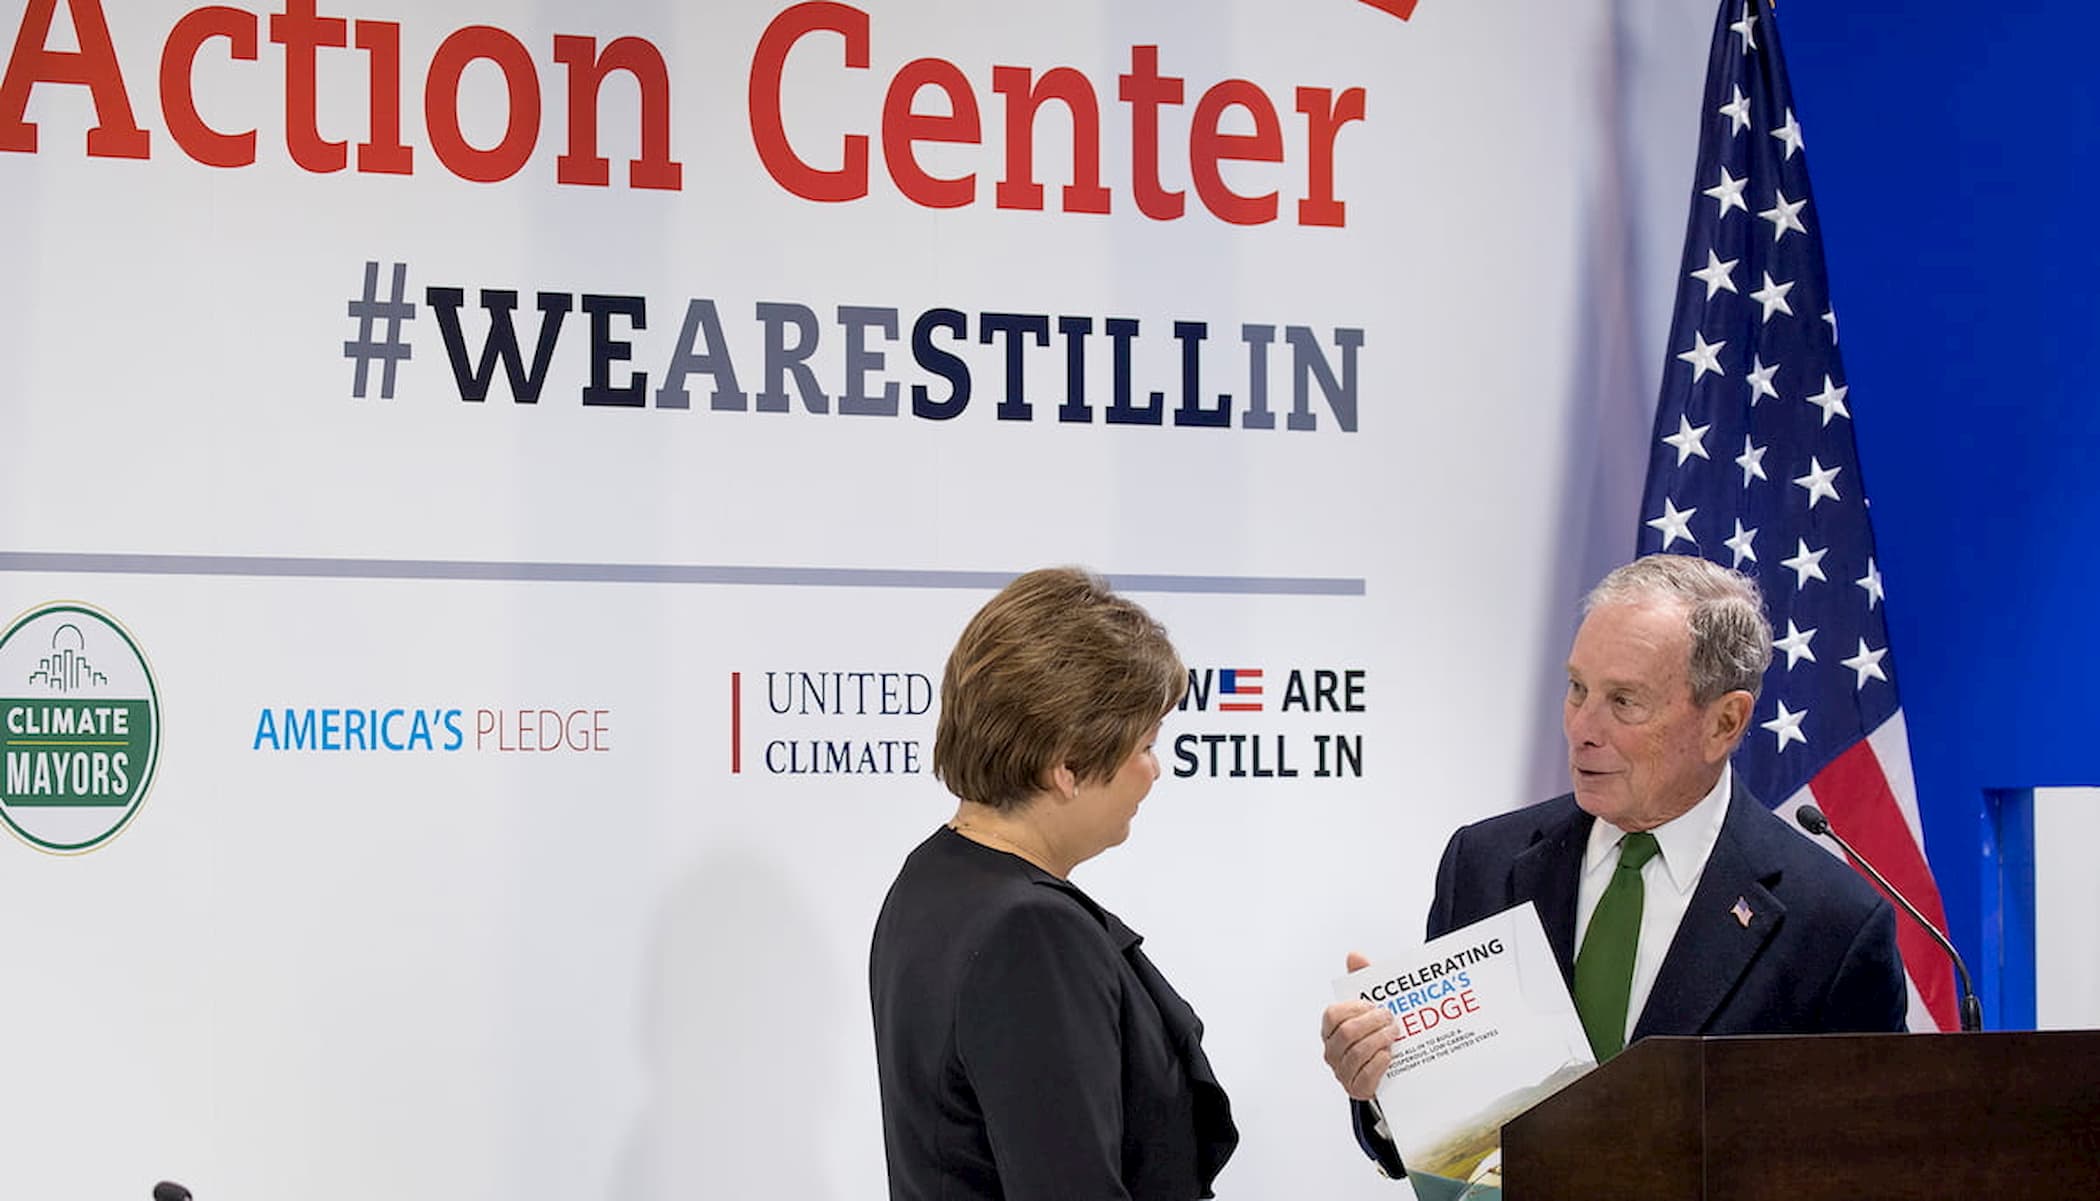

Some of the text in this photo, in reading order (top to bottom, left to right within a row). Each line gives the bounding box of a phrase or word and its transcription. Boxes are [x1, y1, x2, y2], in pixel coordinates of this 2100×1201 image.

[0, 0, 1366, 228] Action Center
[344, 261, 1365, 433] #WEARESTILLIN
[765, 671, 933, 715] UNITED
[1281, 669, 1366, 712] ARE
[7, 707, 129, 735] CLIMATE
[252, 708, 610, 752] AMERICA'S PLEDGE
[7, 751, 129, 796] MAYORS
[765, 740, 921, 774] CLIMATE
[1173, 733, 1363, 778] STILL IN
[1377, 971, 1471, 1016] MERICA'S
[1387, 1029, 1499, 1078] ECONOMY FOR THE UNITED STATES
